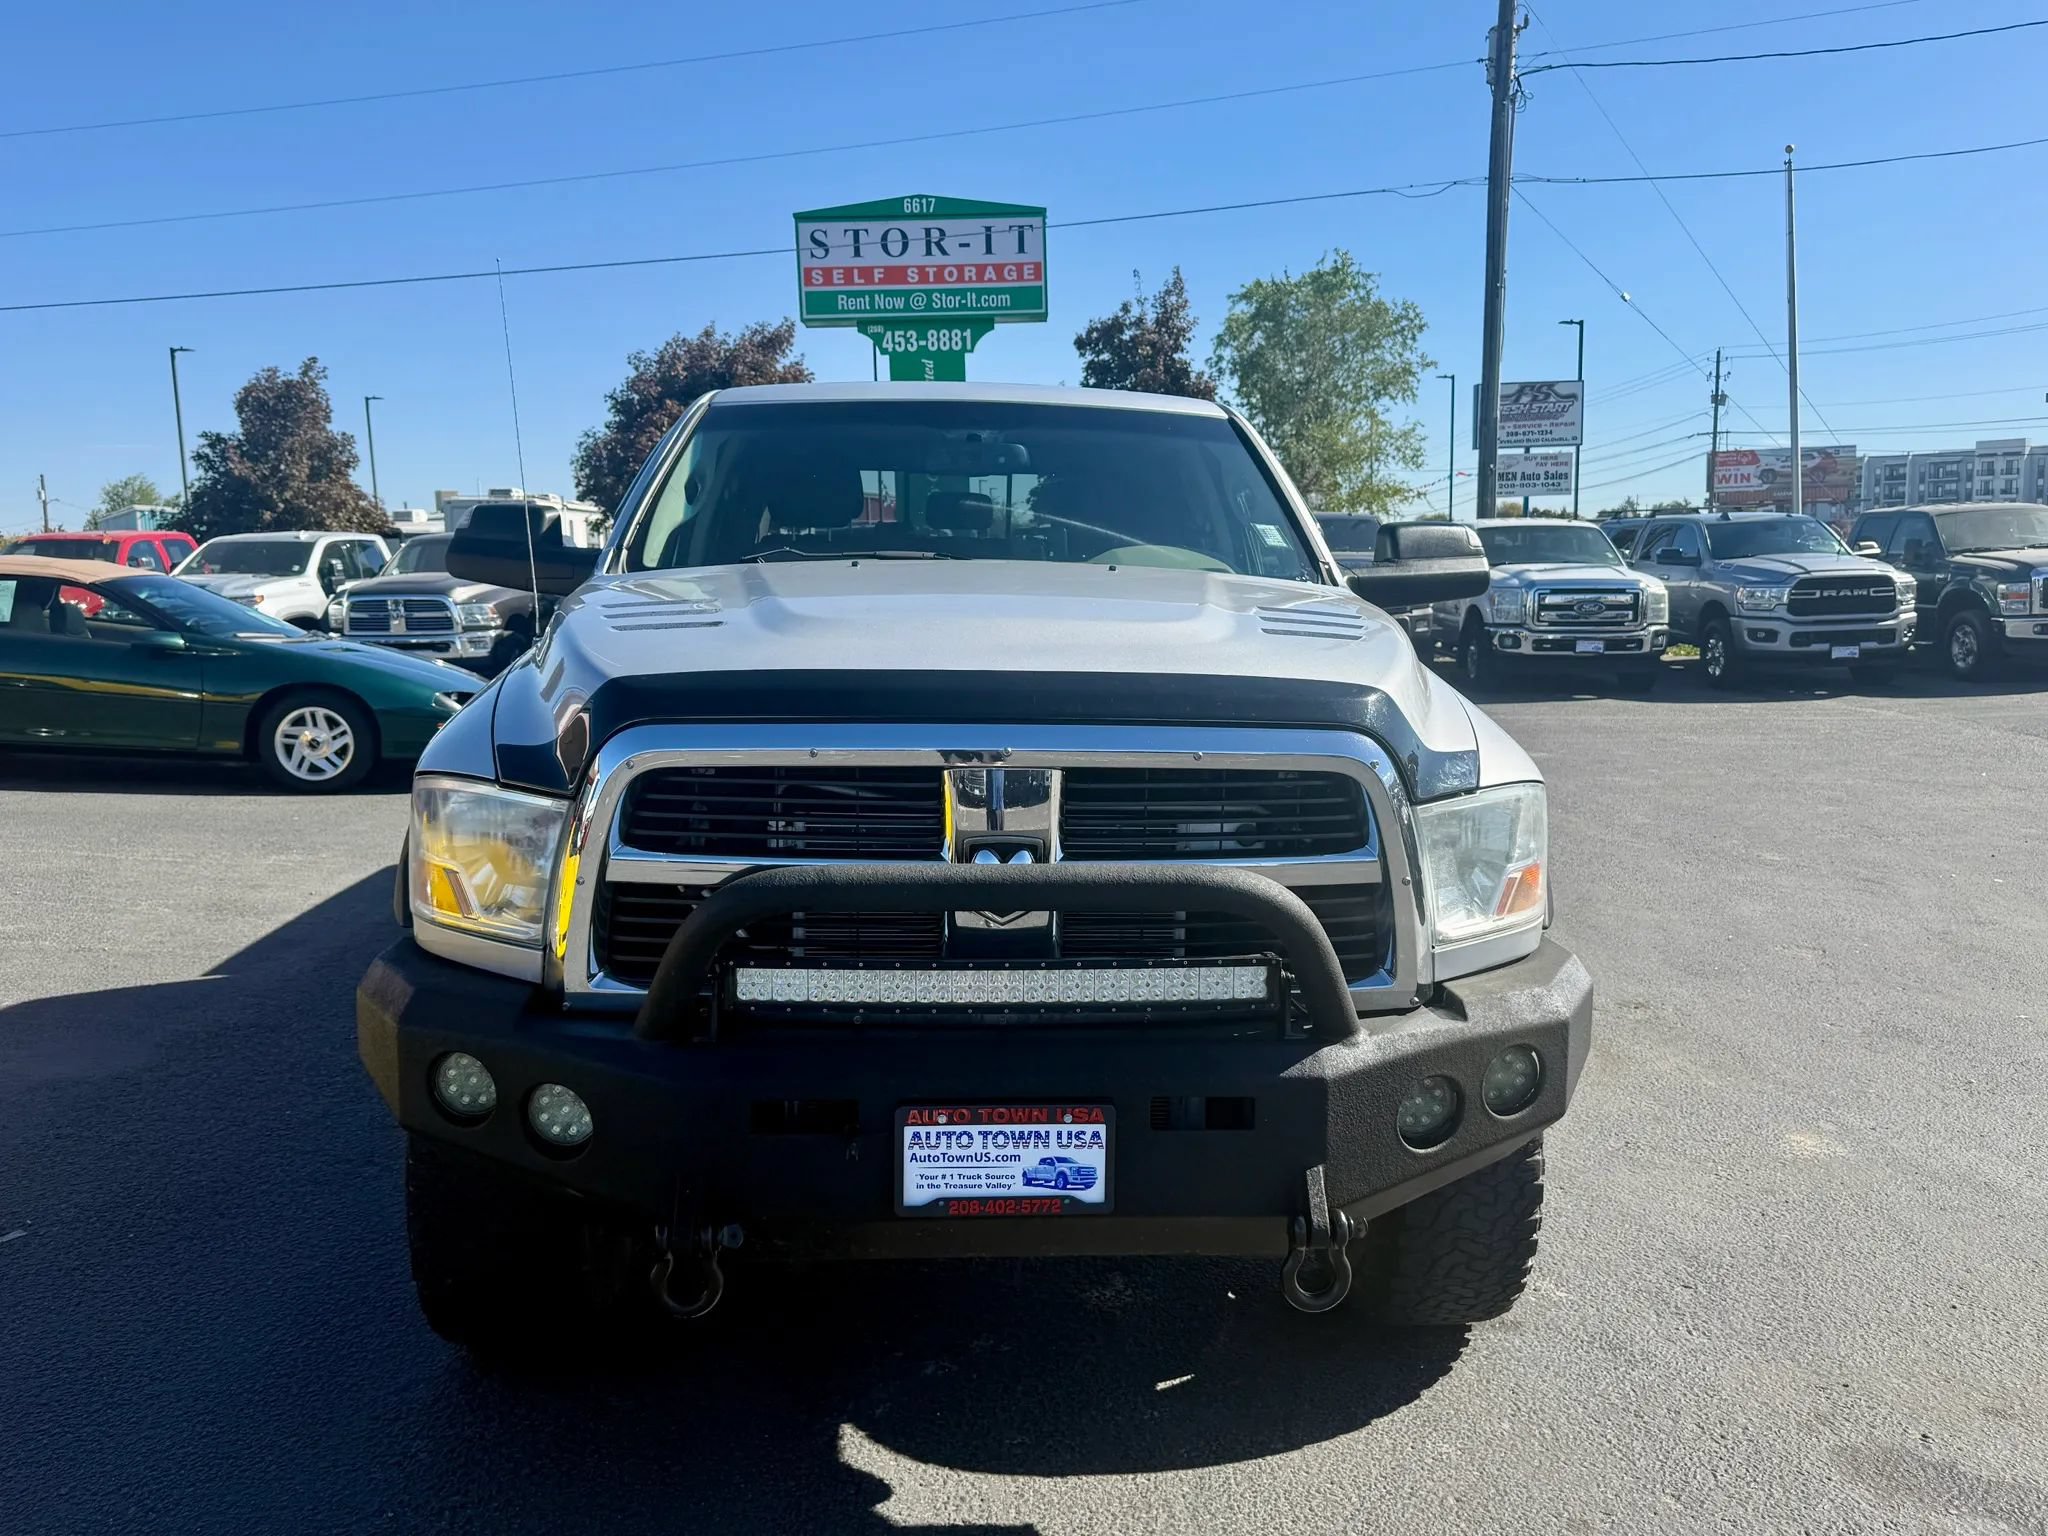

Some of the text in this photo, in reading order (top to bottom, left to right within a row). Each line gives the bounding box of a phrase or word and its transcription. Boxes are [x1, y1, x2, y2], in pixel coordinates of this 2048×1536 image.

[903, 198, 935, 213] 6617
[809, 224, 1033, 259] STOR-IT
[811, 264, 1035, 285] SELF STORAGE
[838, 293, 1011, 310] Rent Now @ Stor-It.com
[882, 328, 972, 352] 453-8881
[1530, 402, 1573, 413] START
[1520, 471, 1541, 481] Auto
[1543, 470, 1568, 480] Sales
[1717, 473, 1751, 484] WIN
[908, 1108, 1104, 1124] AUTO TOWN USA
[908, 1130, 1104, 1150] AUTO TOWN USA
[909, 1152, 1021, 1163] AutoTownUS.com
[949, 1199, 1061, 1215] 208-402-5772
